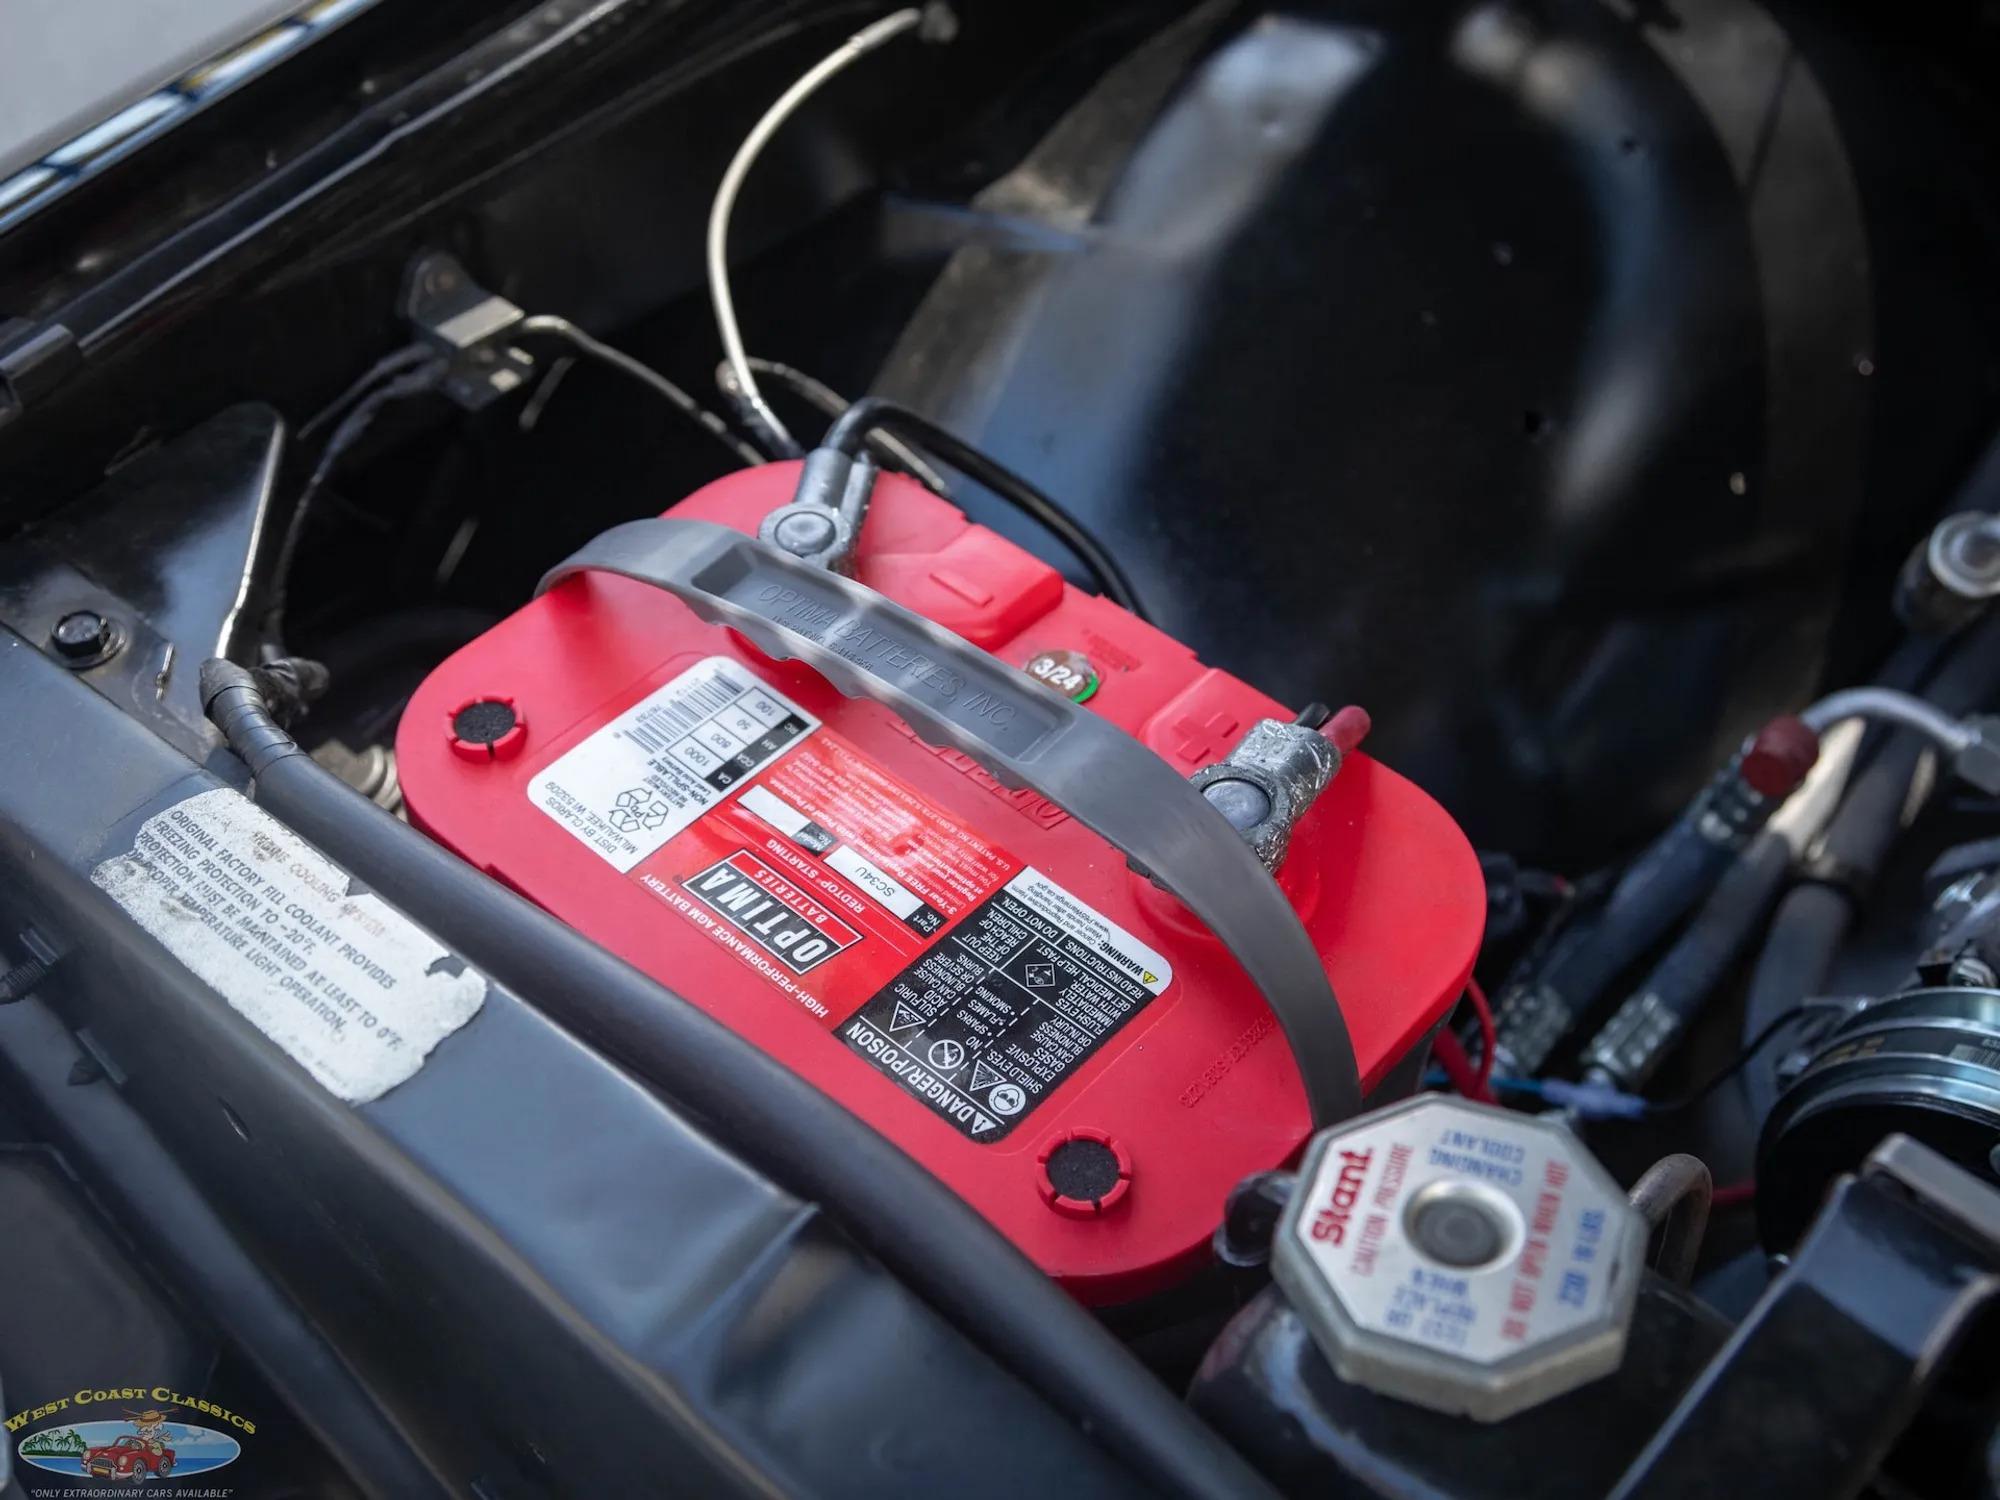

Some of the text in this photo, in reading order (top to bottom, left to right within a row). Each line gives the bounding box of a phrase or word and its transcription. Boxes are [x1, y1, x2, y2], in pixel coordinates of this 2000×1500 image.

[1032, 657, 1083, 690] 3/24
[754, 699, 777, 716] 100
[734, 718, 752, 730] 50
[682, 745, 712, 767] 1000
[543, 780, 576, 806] 53209
[646, 758, 709, 805] NON-SPILLABLE
[715, 771, 733, 784] CA
[544, 795, 584, 828] CLARIOS
[812, 809, 838, 827] Proof
[580, 824, 596, 837] BY
[153, 819, 200, 861] FREEZING
[197, 857, 262, 913] PROTECTION
[260, 908, 279, 926] TO
[763, 837, 820, 879] STARTING
[752, 868, 830, 924] BATTERIES
[852, 865, 897, 897] SC34U
[902, 873, 930, 894] FREE
[169, 808, 396, 991] ORIGINAL FACTORY FILL COOLANT PROVIDES
[926, 891, 958, 914] 3-Year
[1025, 894, 1066, 923] Reproductive
[1051, 903, 1069, 916] after
[135, 830, 198, 885] PROTECTION
[221, 902, 240, 921] BE
[236, 913, 308, 973] MAINTAINED
[321, 980, 362, 1016] LEAST
[357, 1009, 378, 1030] TO
[696, 867, 831, 965] OPTIMA
[910, 914, 935, 932] Part
[922, 911, 942, 926] No.
[977, 917, 1020, 947] REACH OF
[983, 907, 1029, 940] CHILDREN.
[998, 895, 1059, 938] DO NOT OPEN.
[1060, 919, 1075, 930] and
[1064, 912, 1087, 928] hands
[638, 871, 830, 1017] HIGH-PERFORMANCE AGM BATTERY
[960, 932, 1003, 962] KEEP OUT
[979, 931, 1012, 955] OF THE
[1071, 926, 1097, 945] Cancer
[1082, 925, 1103, 940] Wash
[179, 892, 248, 952] TEMPERATURE
[244, 946, 281, 979] LIGHT
[278, 974, 348, 1033] OPERATION.
[932, 951, 976, 983] OR SEVERE
[953, 952, 985, 975] BURNS.
[1060, 939, 1145, 999] READ INSTRUCTIONS.
[1094, 939, 1146, 976] WARNING:
[912, 966, 958, 999] CAN CAUSE
[921, 957, 966, 991] BLINDNESS
[1034, 942, 1132, 1012] GET MEDICAL HELP FAST.
[892, 982, 939, 1016] SULFURIC
[921, 988, 948, 1008] ACID
[966, 998, 1001, 1024] FLAMES
[973, 985, 1013, 1014] SMOKING
[1057, 986, 1115, 1027] IMMEDIATELY
[1066, 979, 1123, 1019] WITH WATER.
[954, 1008, 990, 1034] SPARKS
[1047, 1014, 1093, 1047] OR INJURY.
[1053, 997, 1106, 1035] FLUSH EYES
[964, 1034, 984, 1049] NO
[1029, 1029, 1076, 1063] CAN CAUSE
[1037, 1021, 1084, 1055] BLINDNESS
[843, 1021, 977, 1122] DANGER/POISON
[982, 1048, 1044, 1093] SHIELD EYES.
[1003, 1043, 1057, 1082] EXPLOSIVE
[1031, 1046, 1067, 1072] GASES
